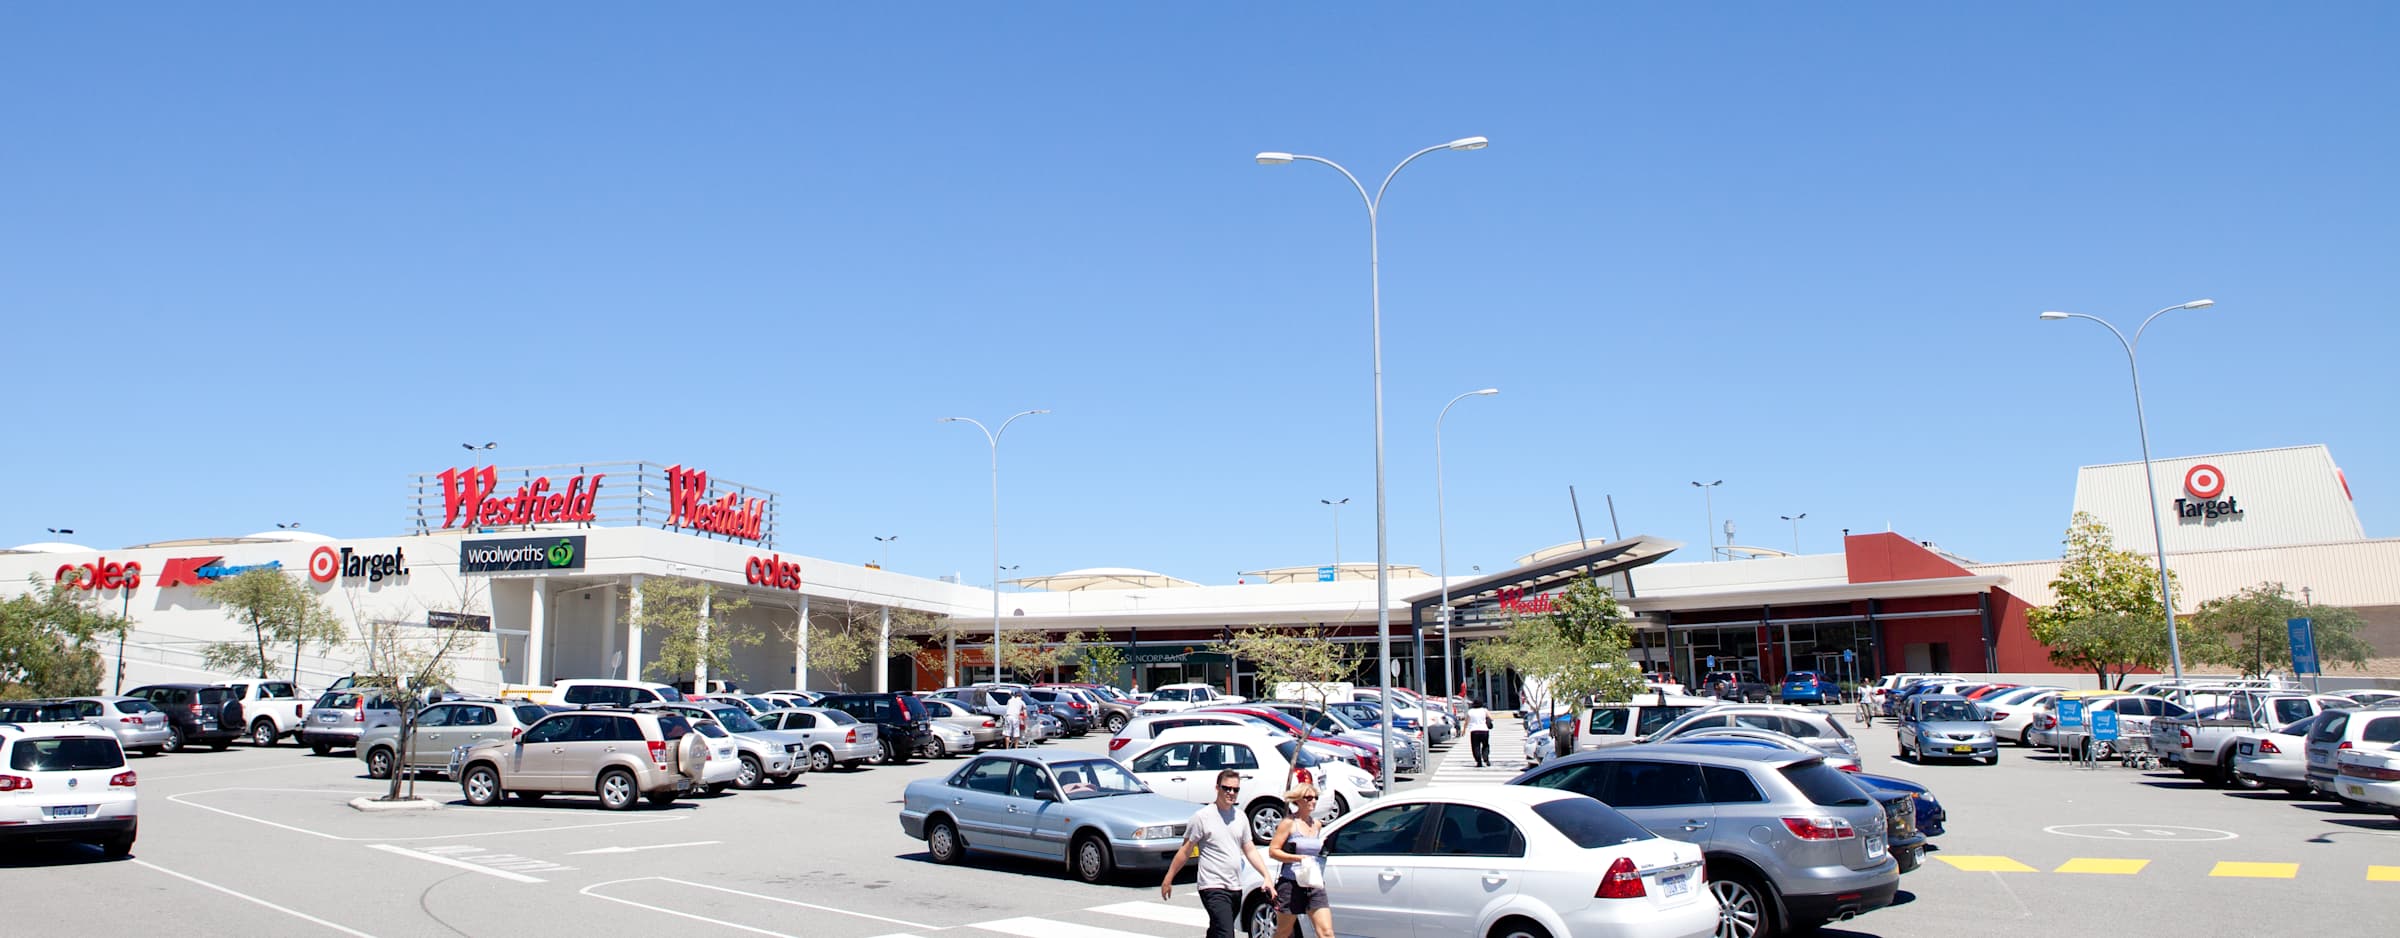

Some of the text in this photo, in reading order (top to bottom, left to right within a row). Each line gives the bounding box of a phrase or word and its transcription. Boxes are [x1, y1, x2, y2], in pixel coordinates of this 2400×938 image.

[436, 464, 606, 529] Westfield
[664, 463, 768, 540] Westfield
[2174, 495, 2243, 519] Target.
[340, 546, 410, 582] Target.
[468, 544, 545, 565] Woolworths
[55, 556, 141, 591] coles
[745, 553, 803, 592] coles
[1495, 586, 1568, 615] Westfi
